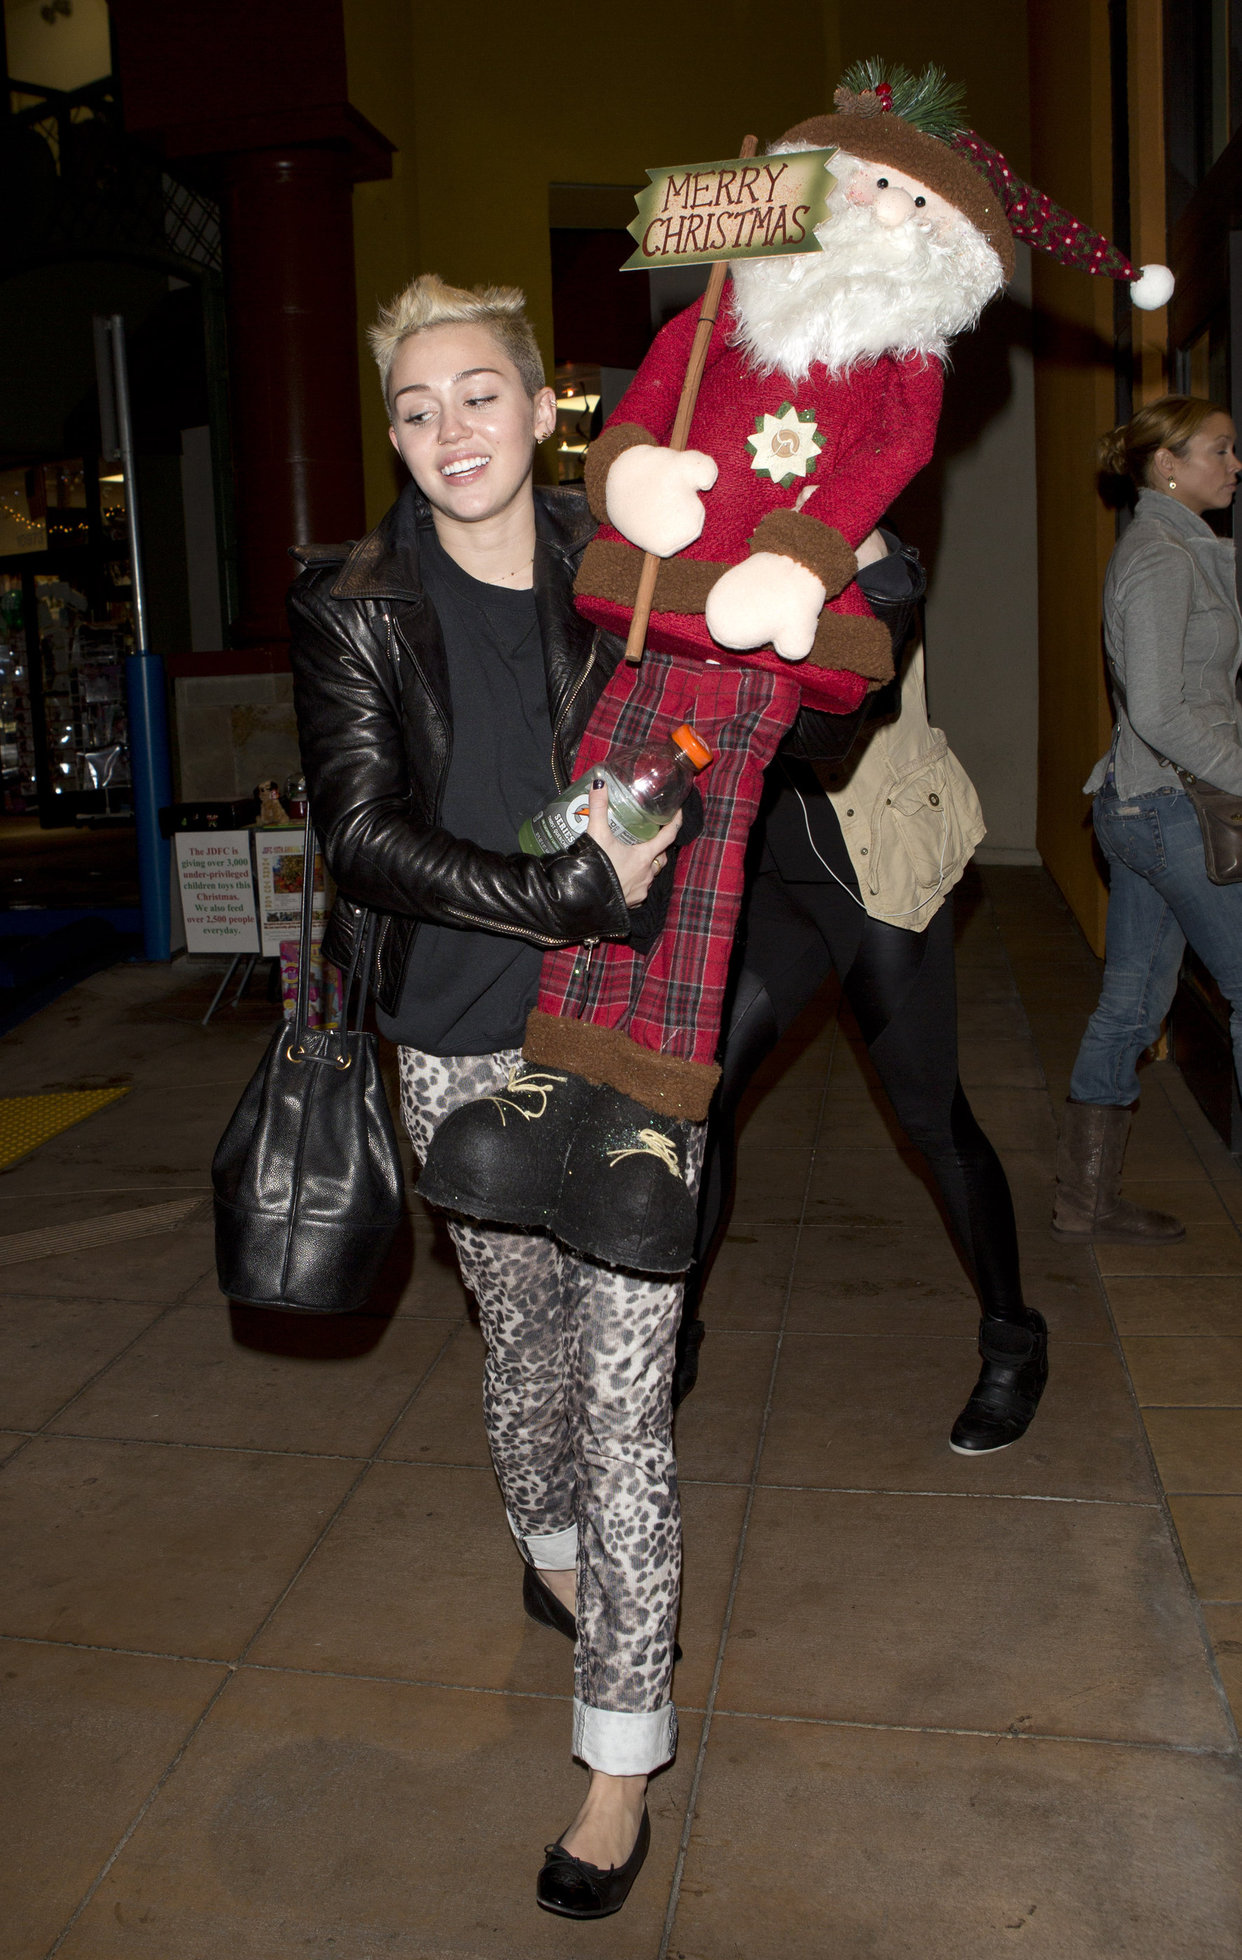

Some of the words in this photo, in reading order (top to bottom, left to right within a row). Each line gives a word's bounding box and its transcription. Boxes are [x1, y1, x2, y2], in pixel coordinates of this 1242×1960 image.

[661, 163, 789, 213] MERRY
[642, 204, 811, 257] CHRISTMAS
[554, 813, 576, 843] SERIES
[553, 828, 570, 850] QUENCHE
[189, 847, 204, 856] The
[206, 847, 230, 856] JDFC
[232, 846, 239, 855] is
[181, 859, 206, 869] giving
[226, 858, 249, 868] 3,000
[183, 869, 249, 880] under-privileged
[183, 881, 216, 890] children
[218, 882, 234, 891] toys
[236, 881, 251, 889] this
[196, 892, 239, 901] Christmas.
[194, 904, 208, 912] We
[210, 903, 226, 912] also
[227, 903, 244, 912] feed
[187, 916, 204, 924] over
[206, 915, 227, 924] 2,500
[229, 915, 255, 925] people
[202, 927, 241, 936] everyday.
